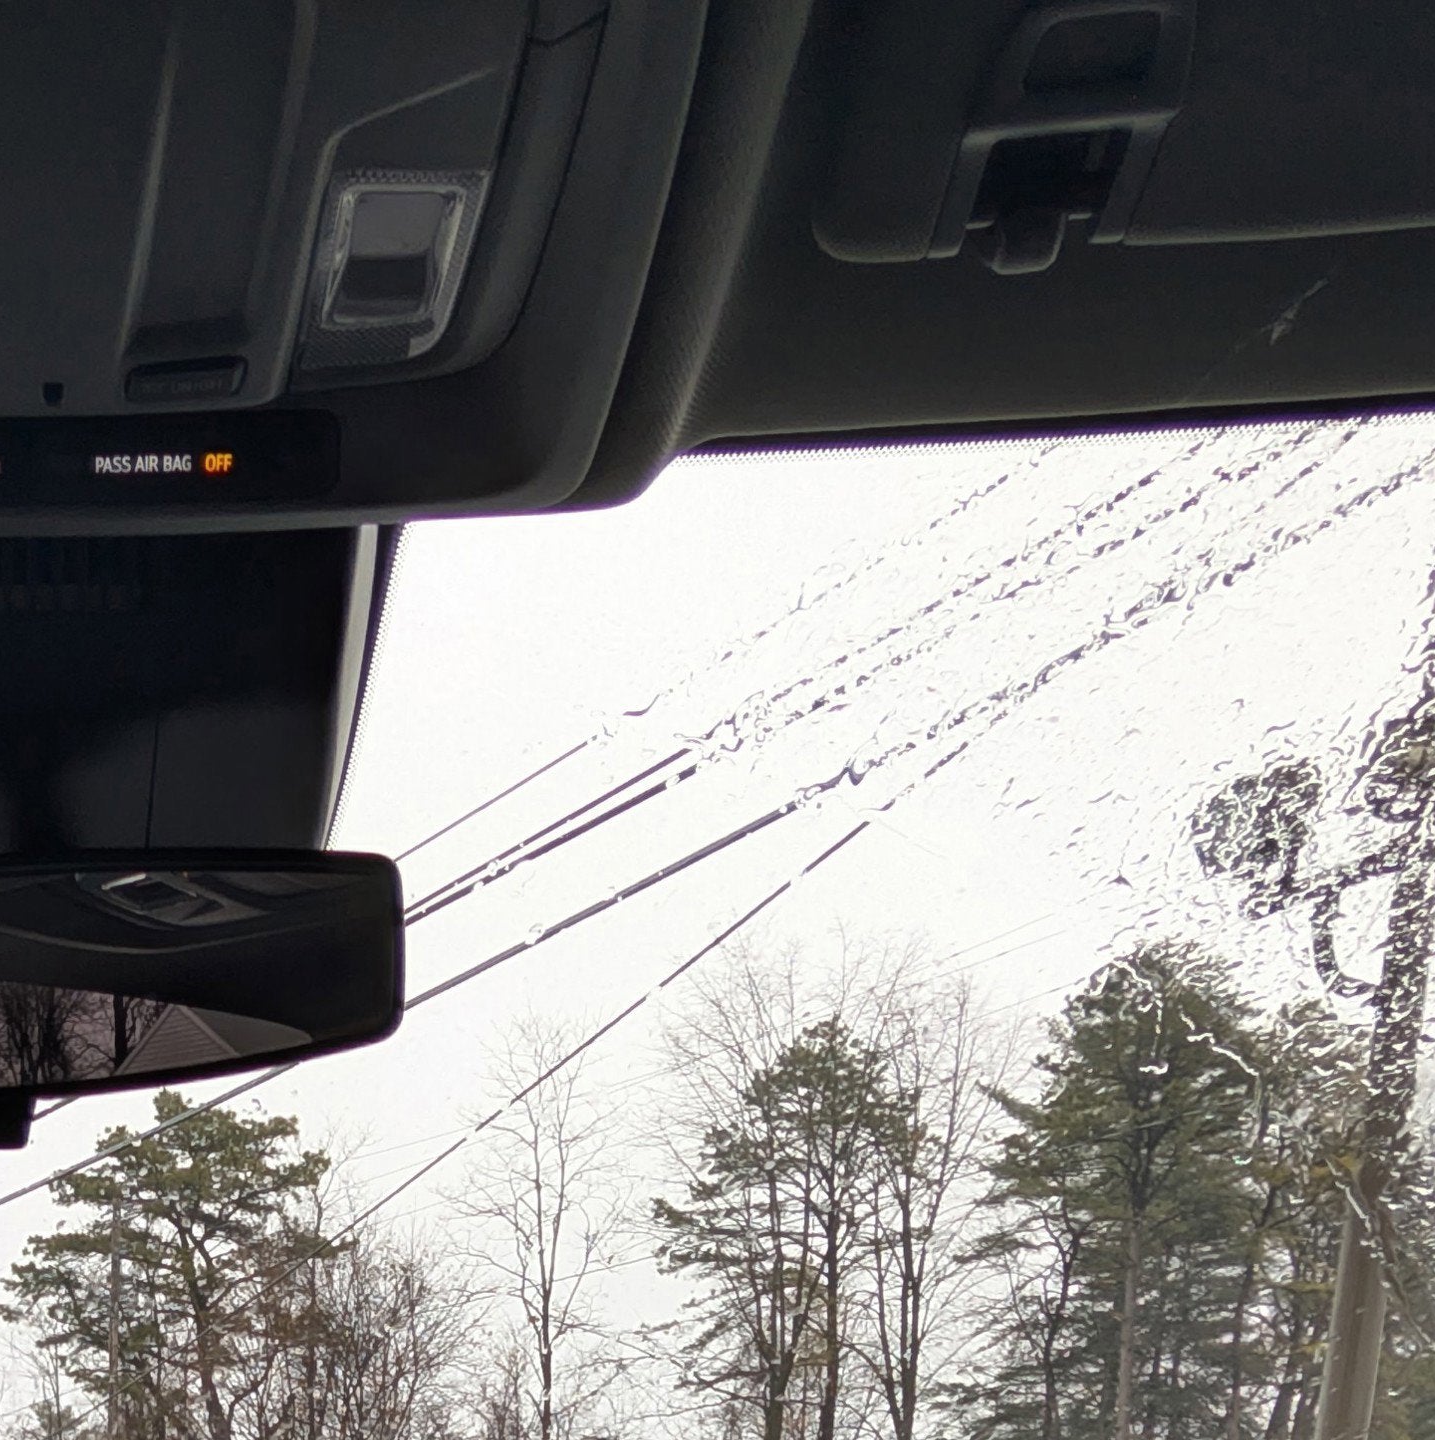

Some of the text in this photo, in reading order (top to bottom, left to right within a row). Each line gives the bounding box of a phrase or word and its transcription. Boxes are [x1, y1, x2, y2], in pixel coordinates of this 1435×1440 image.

[95, 453, 233, 474] PASS AIR BAG OFF
